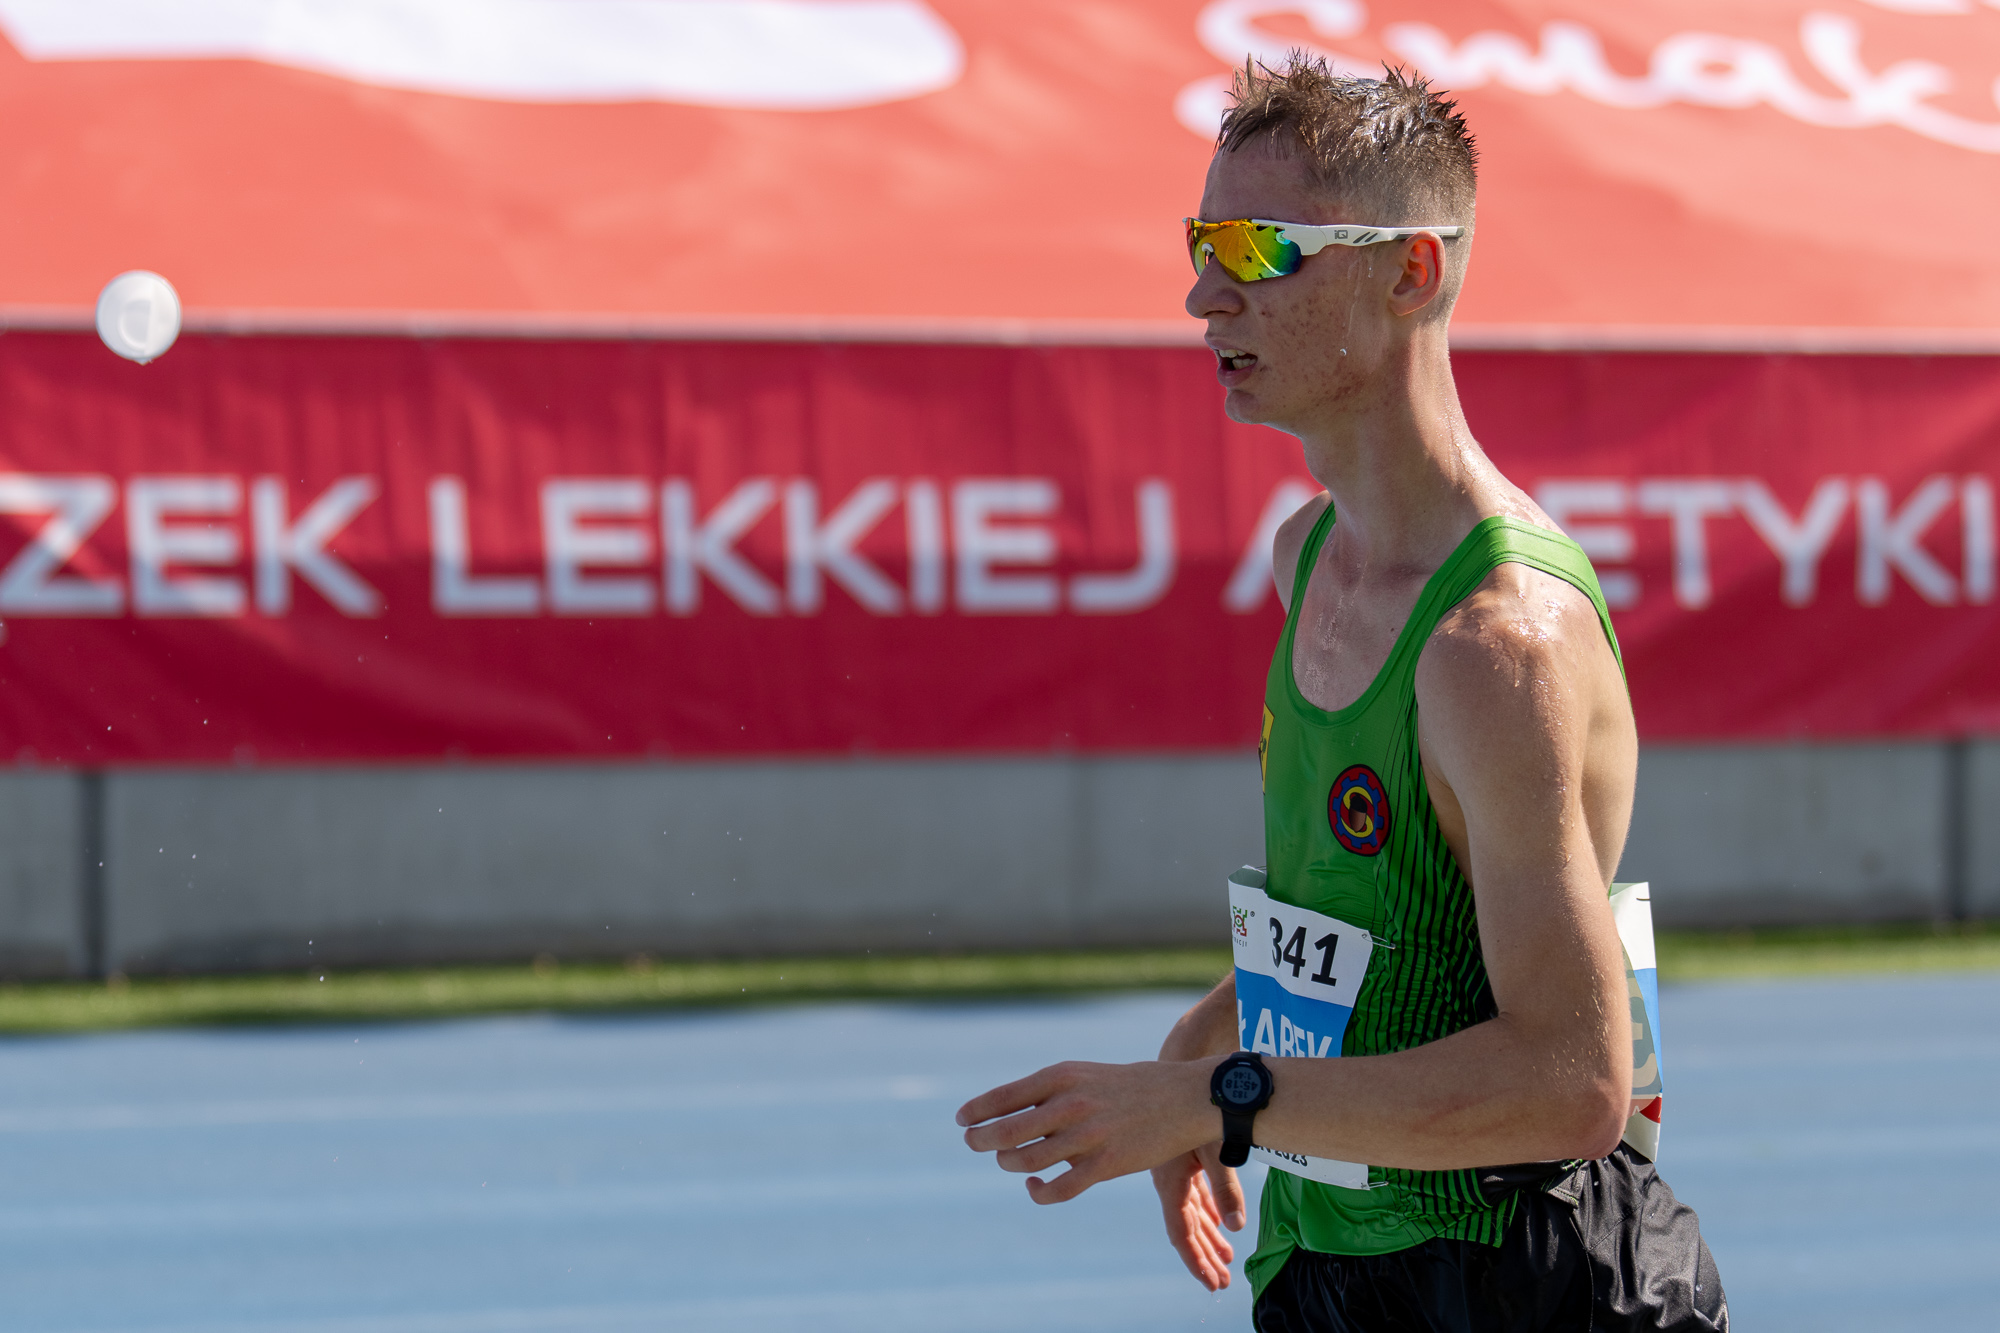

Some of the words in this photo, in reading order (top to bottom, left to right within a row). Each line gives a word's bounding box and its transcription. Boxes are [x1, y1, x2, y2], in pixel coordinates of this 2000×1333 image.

[1174, 0, 2000, 154] Smak
[0, 472, 382, 616] ZEK
[427, 474, 1178, 616] LEKKIEJ
[1223, 476, 1998, 610] ETYKI
[1269, 917, 1339, 987] 341
[1225, 1079, 1258, 1091] 45:18
[1232, 1090, 1248, 1099] 183
[1233, 1071, 1251, 1080] 1:46
